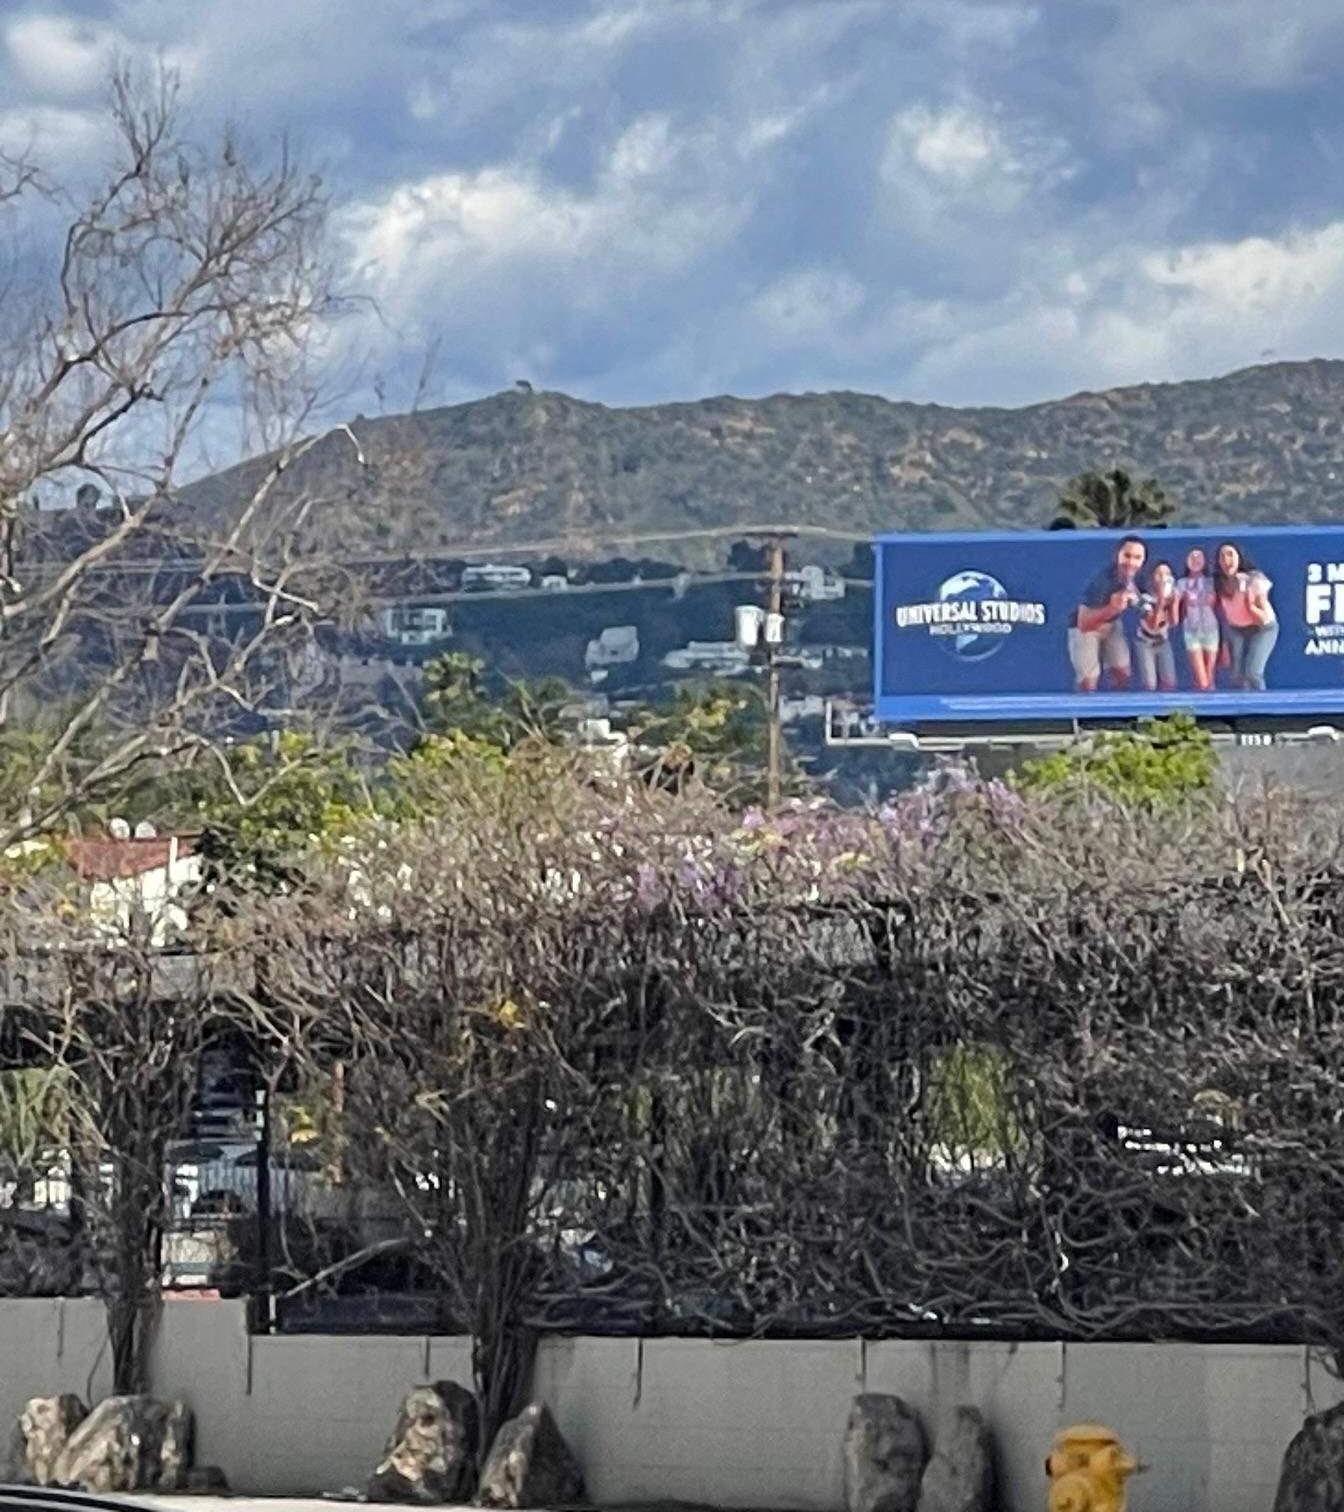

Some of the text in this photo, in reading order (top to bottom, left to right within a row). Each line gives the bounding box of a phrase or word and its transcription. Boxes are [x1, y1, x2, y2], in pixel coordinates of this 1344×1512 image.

[896, 599, 1045, 627] UNIVERSAL STUDIOS
[929, 622, 1012, 635] HOLLYWOOD
